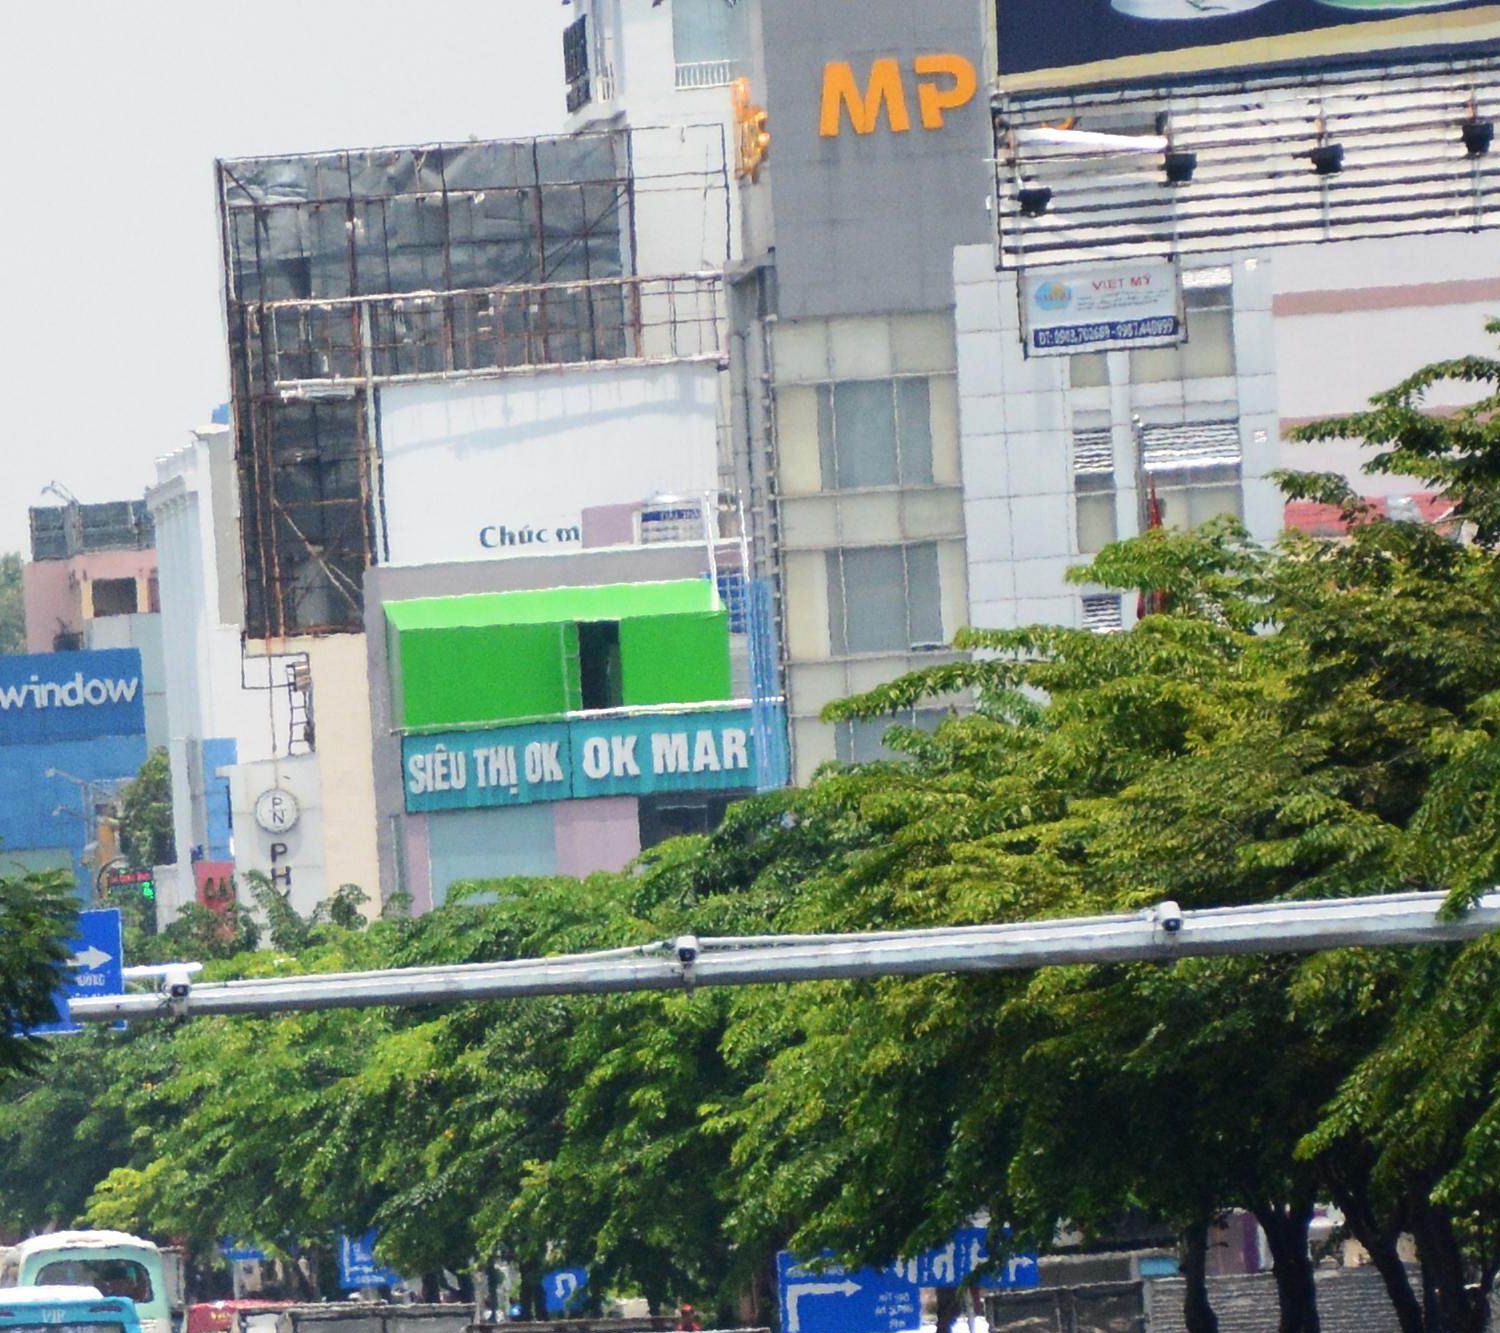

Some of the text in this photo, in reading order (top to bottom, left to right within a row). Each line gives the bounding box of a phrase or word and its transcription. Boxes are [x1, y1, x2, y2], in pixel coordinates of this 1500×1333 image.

[479, 524, 549, 549] Chúc
[408, 740, 564, 795] SIÊU THỊ OK
[581, 727, 750, 780] OK MAR
